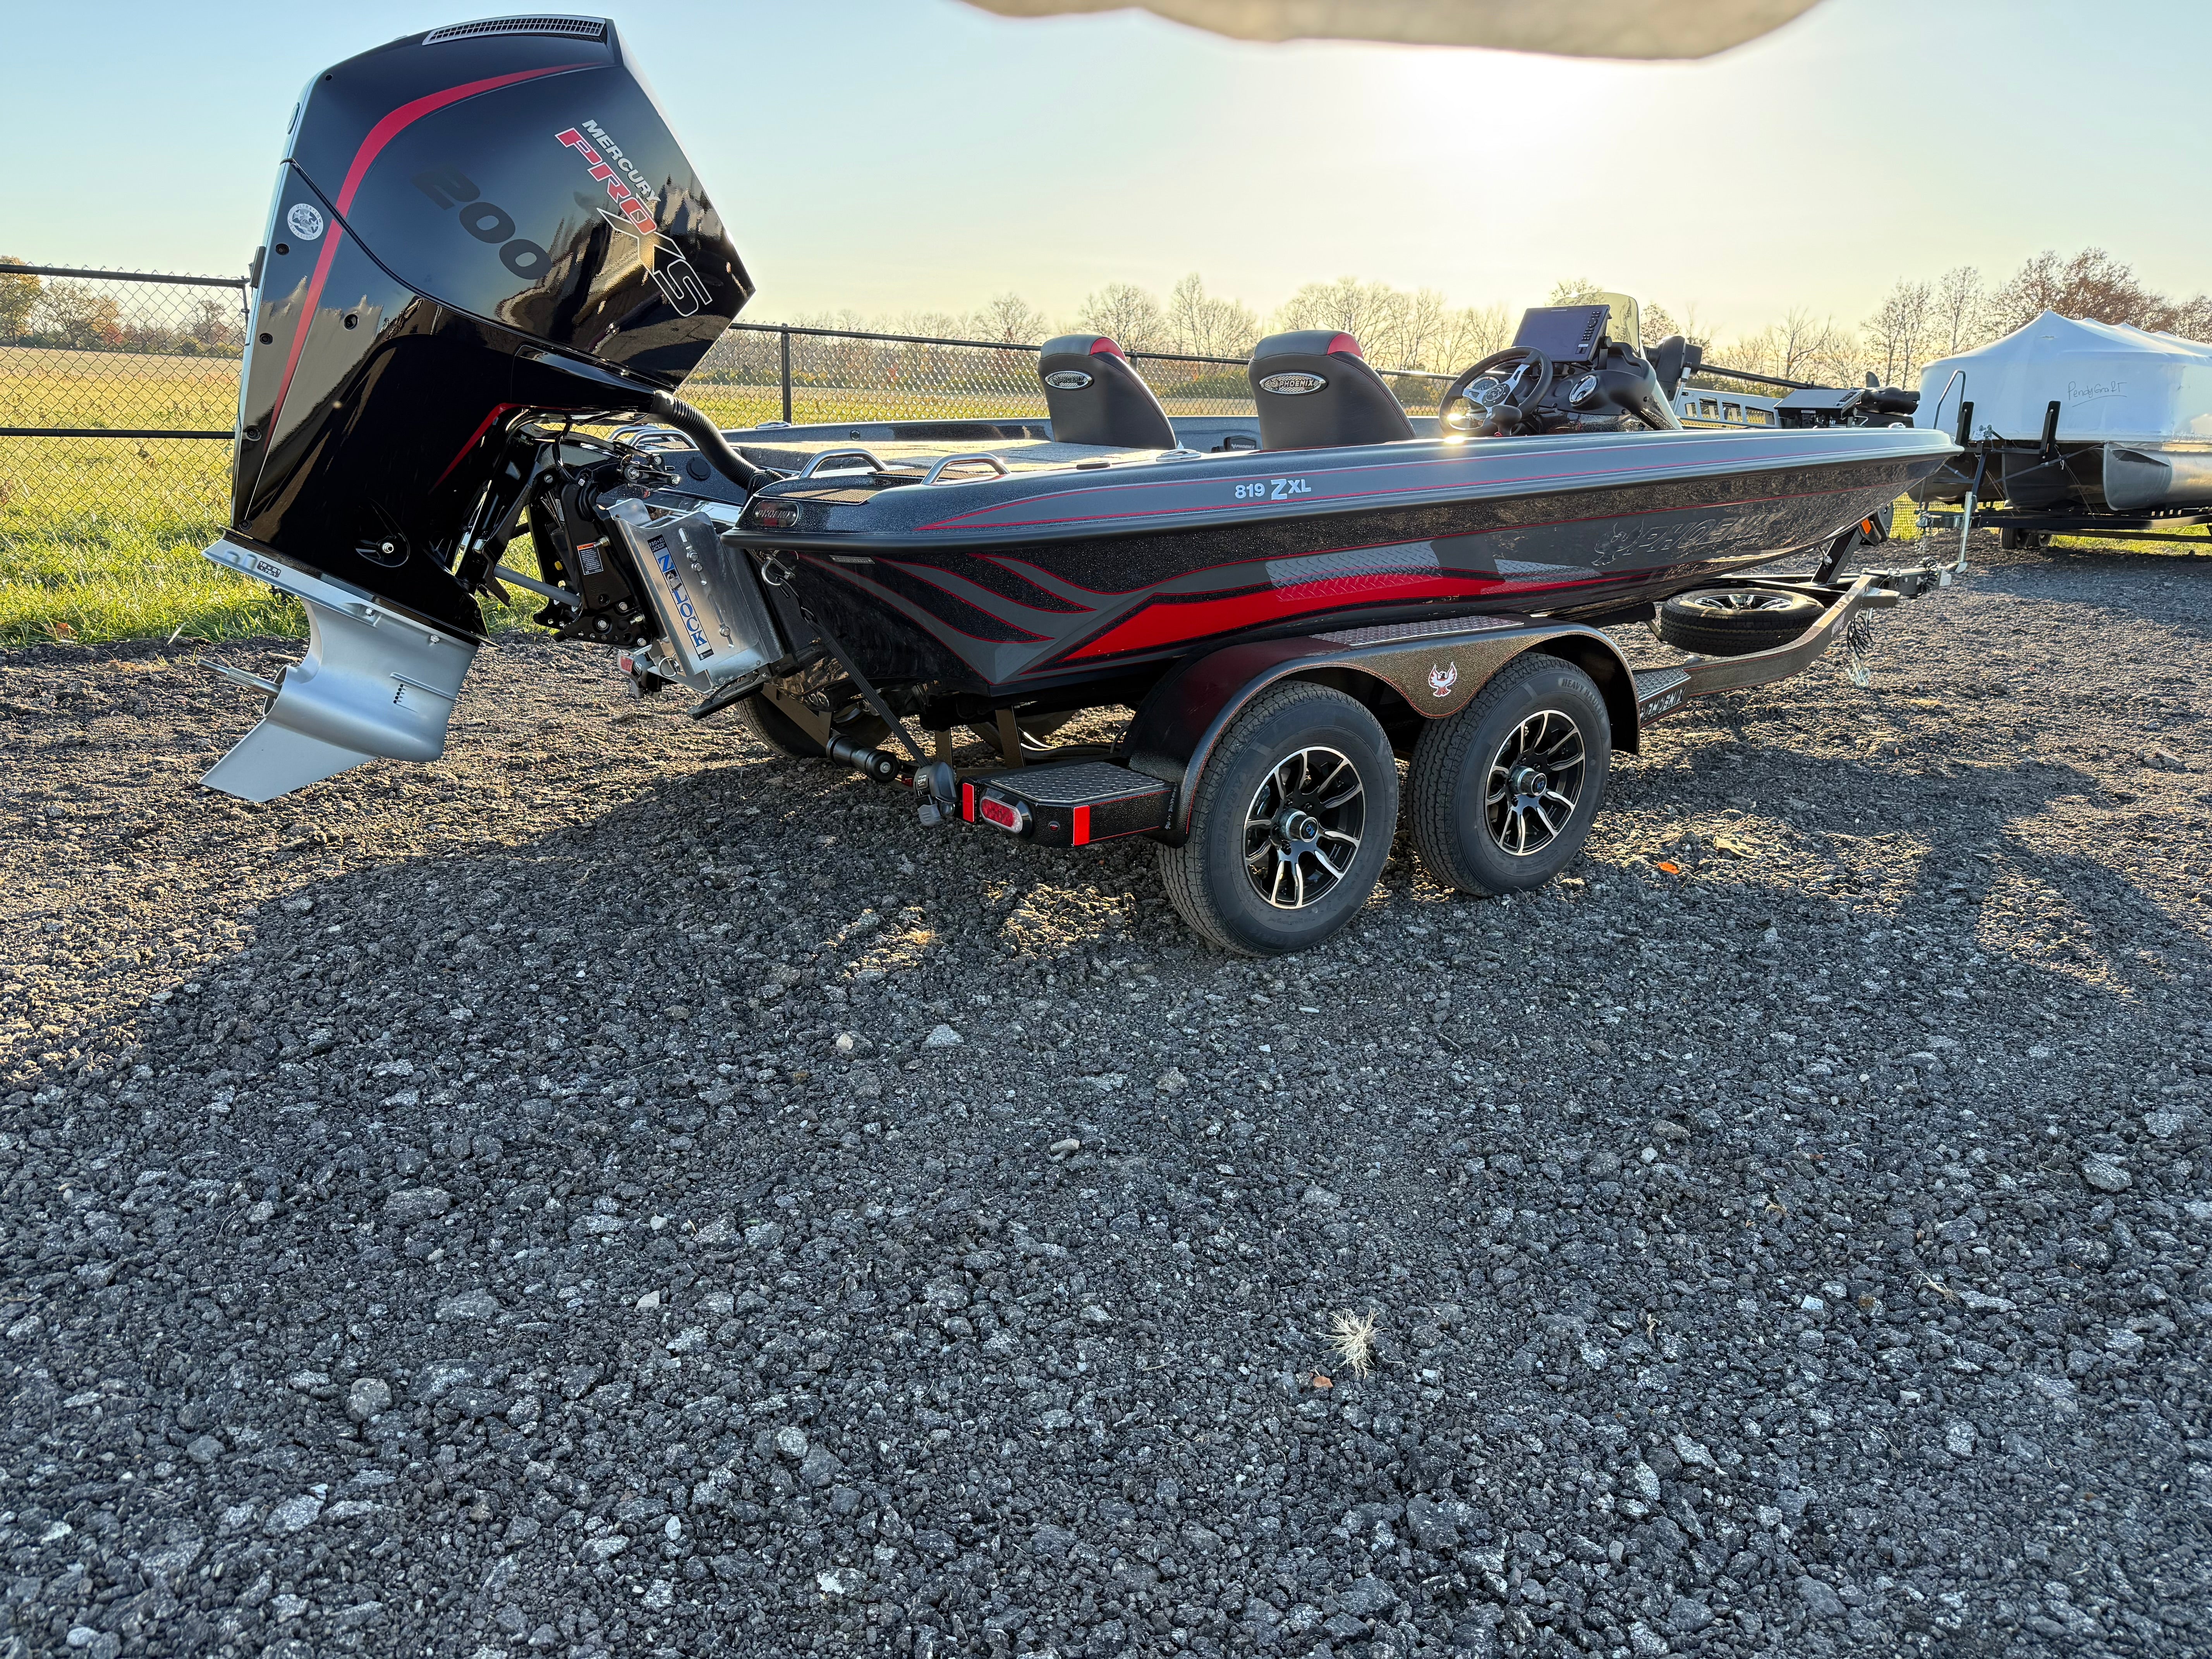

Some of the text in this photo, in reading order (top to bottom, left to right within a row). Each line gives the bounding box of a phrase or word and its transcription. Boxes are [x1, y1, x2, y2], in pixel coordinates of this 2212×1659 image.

[555, 127, 657, 235] PRO
[582, 119, 661, 202] MERCURY
[410, 167, 552, 280] 200
[1235, 483, 1265, 499] 819
[672, 589, 708, 647] LOCK
[1561, 678, 1585, 692] HEAVY
[1217, 776, 1243, 871] JOURNEY
